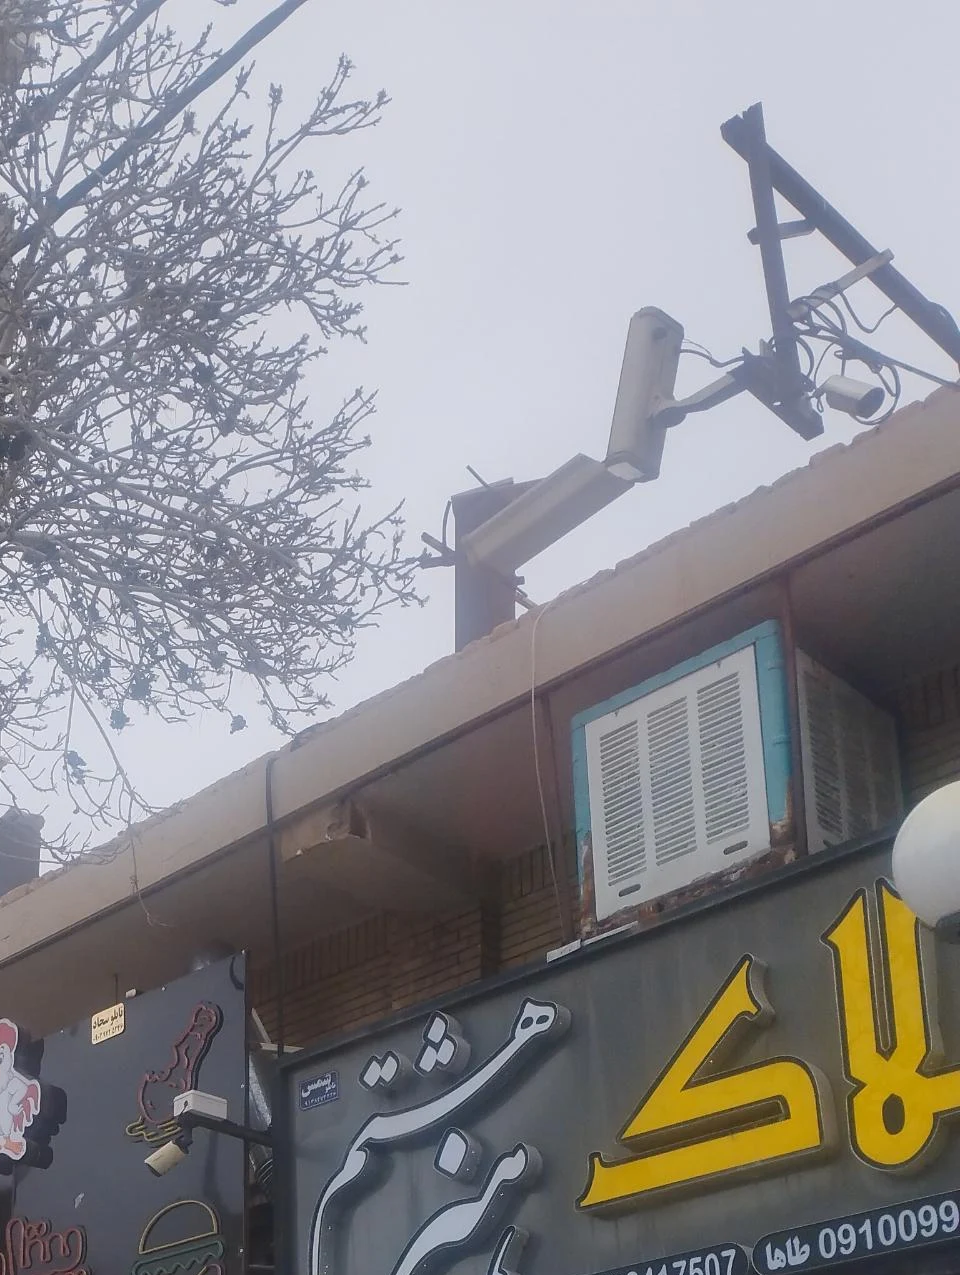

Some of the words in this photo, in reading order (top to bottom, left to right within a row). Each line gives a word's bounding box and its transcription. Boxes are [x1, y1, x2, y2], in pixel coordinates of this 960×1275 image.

[576, 877, 960, 1208] لاک
[764, 1235, 811, 1271] طاها
[818, 1200, 960, 1259] 0910099
